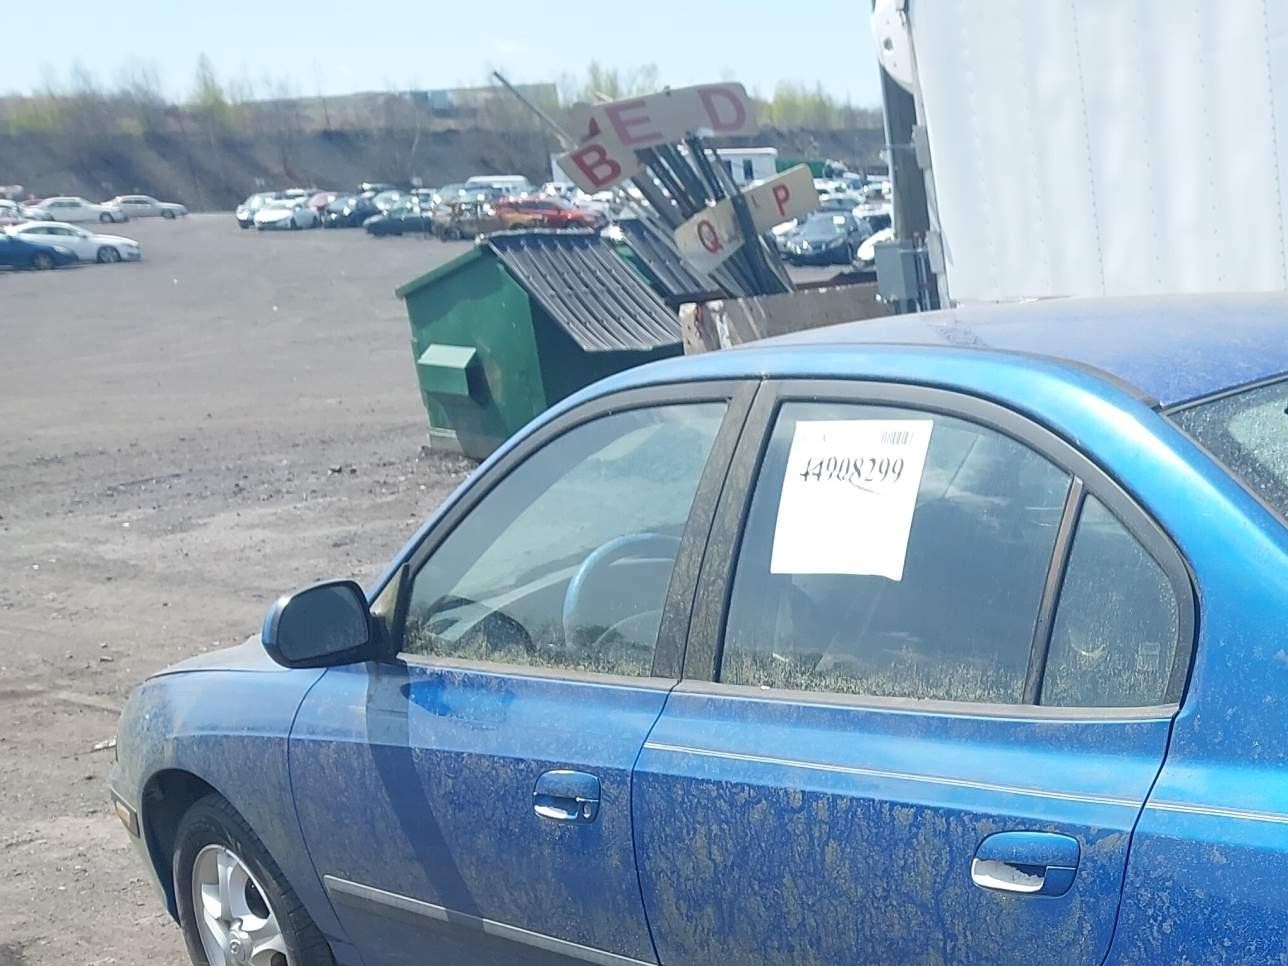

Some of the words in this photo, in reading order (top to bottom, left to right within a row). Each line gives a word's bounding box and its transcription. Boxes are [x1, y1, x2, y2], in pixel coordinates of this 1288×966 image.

[605, 101, 665, 146] E
[697, 88, 747, 133] D
[570, 144, 622, 188] B
[773, 184, 790, 217] P
[697, 219, 724, 255] Q
[799, 456, 905, 483] 44908299
